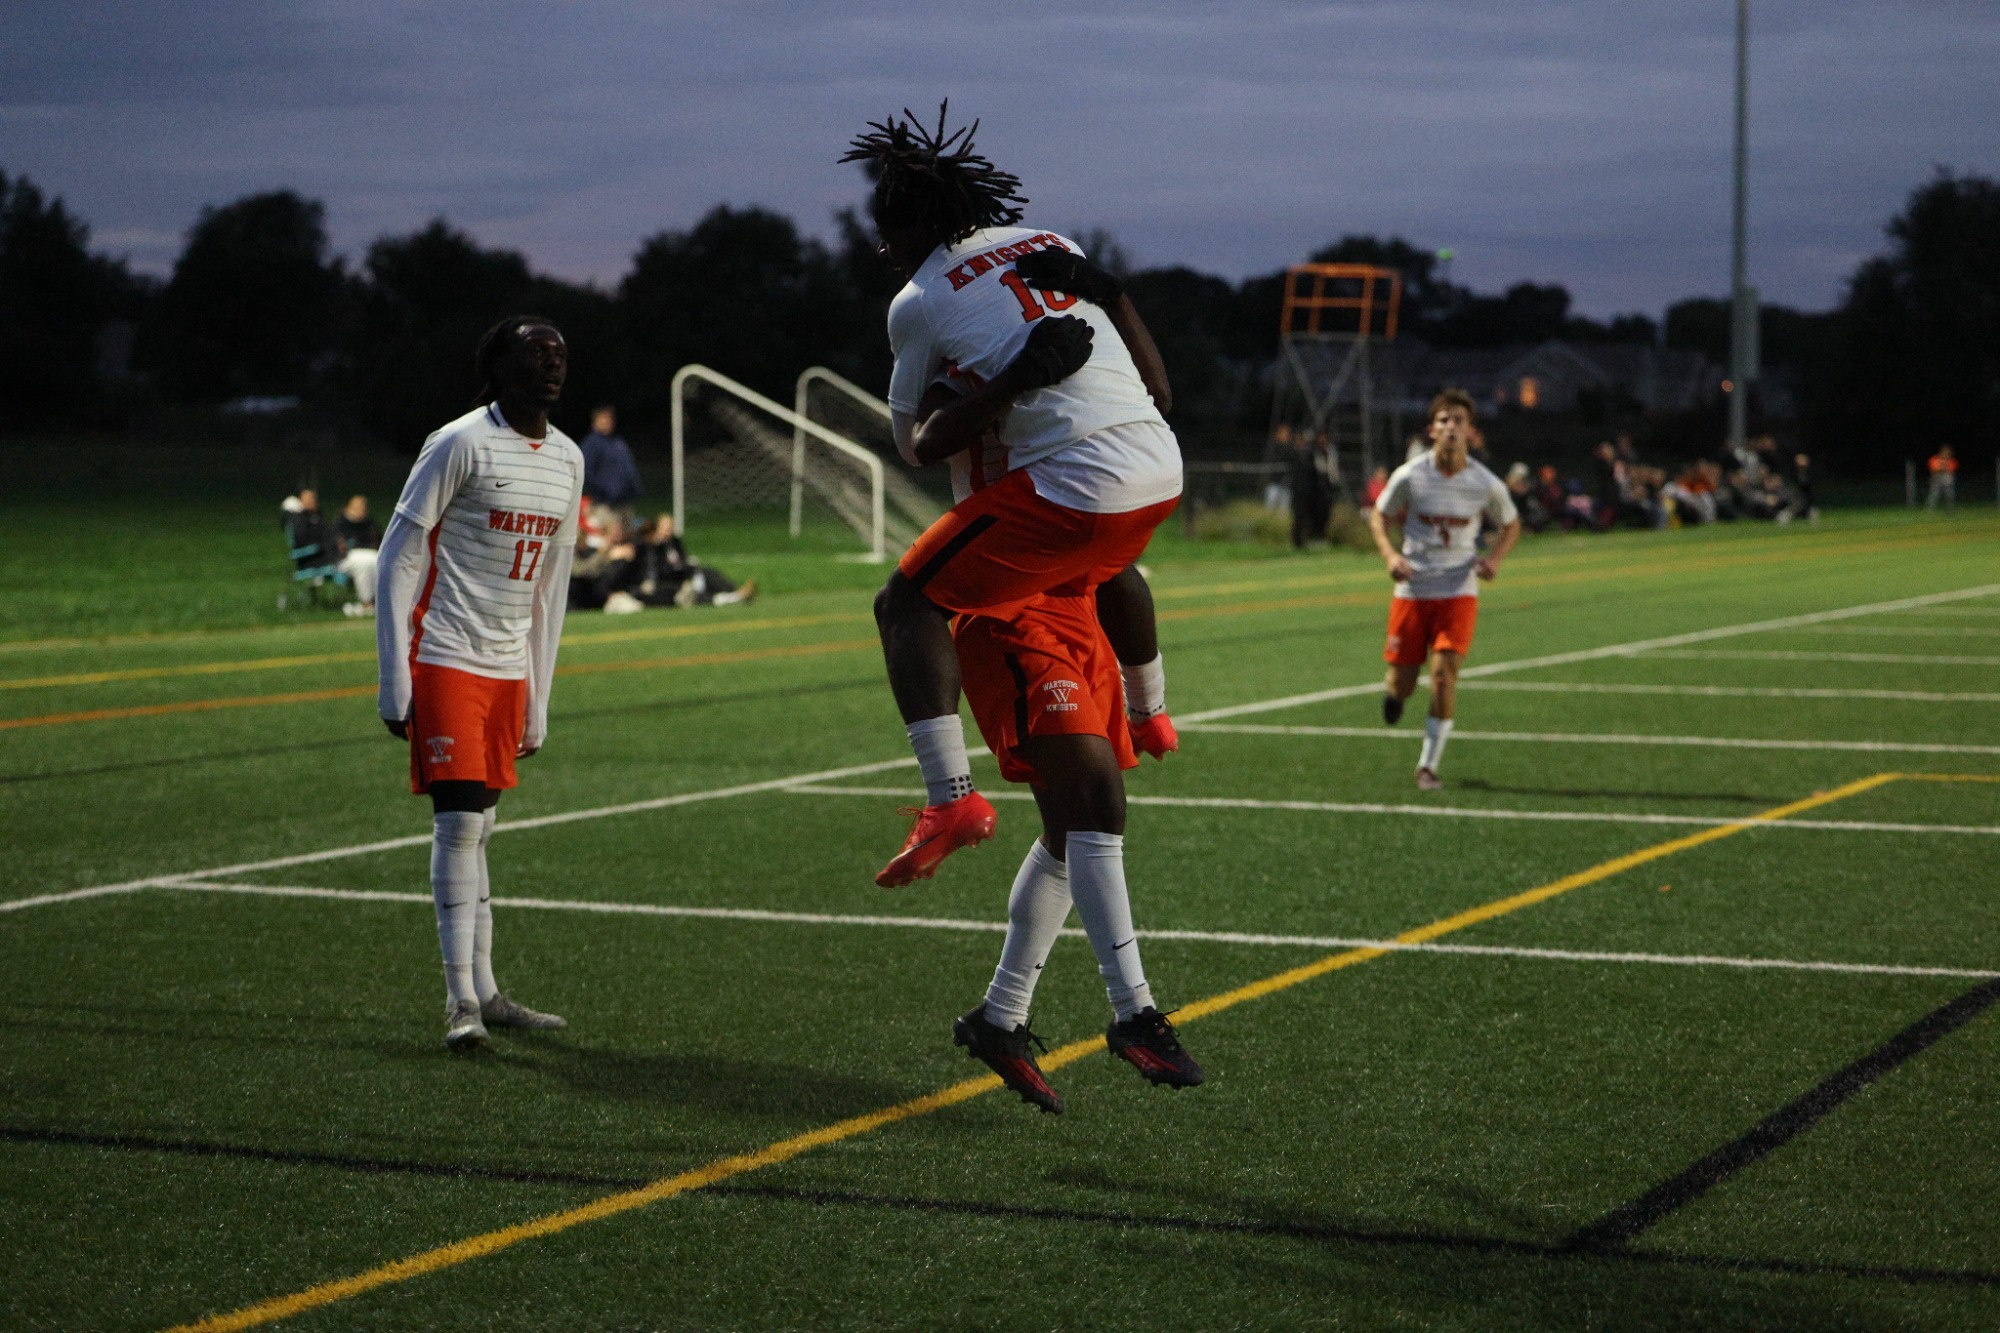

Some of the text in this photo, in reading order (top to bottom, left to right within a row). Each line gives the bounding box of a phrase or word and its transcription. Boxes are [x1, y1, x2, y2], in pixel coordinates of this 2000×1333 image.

[944, 233, 1071, 292] KNIGHTS
[508, 540, 543, 581] 17
[1042, 679, 1079, 691] WARTBURG
[1050, 688, 1072, 703] W
[1046, 703, 1078, 712] KNIGHTS
